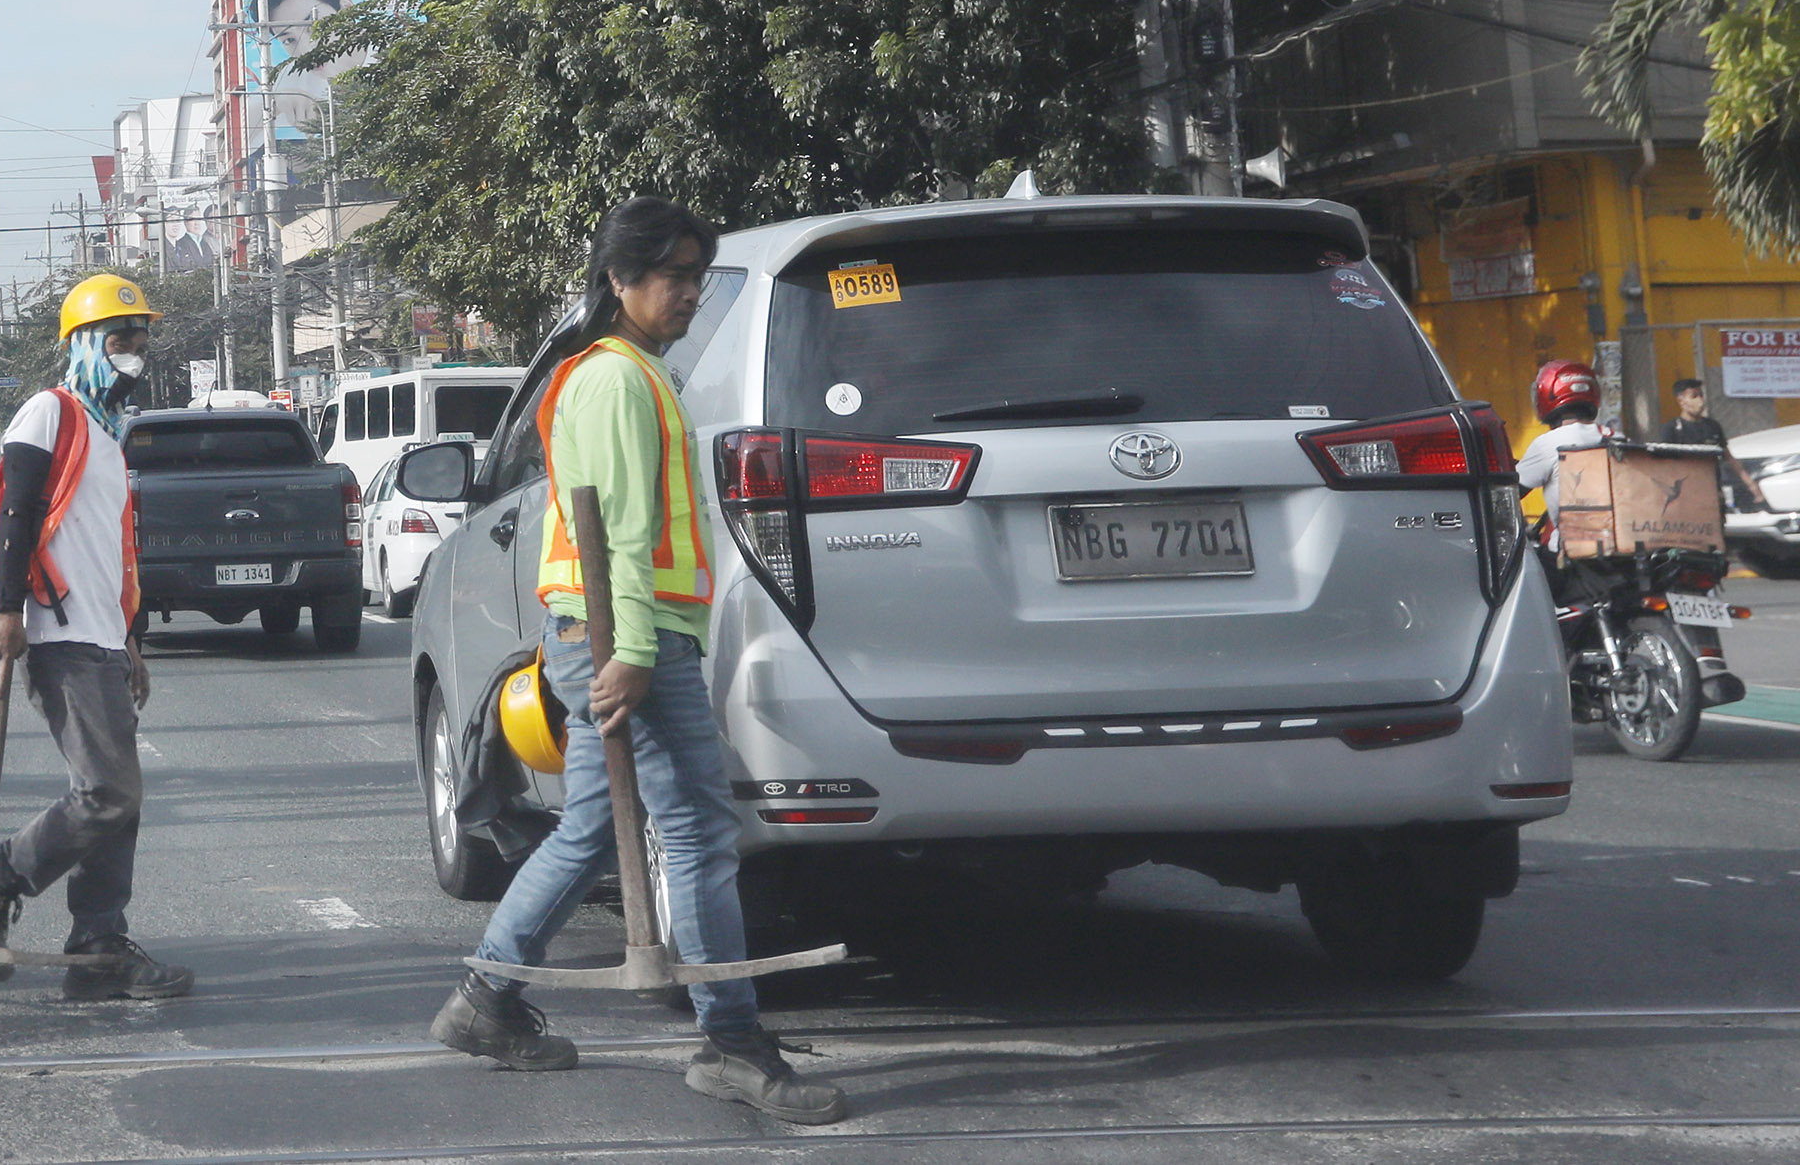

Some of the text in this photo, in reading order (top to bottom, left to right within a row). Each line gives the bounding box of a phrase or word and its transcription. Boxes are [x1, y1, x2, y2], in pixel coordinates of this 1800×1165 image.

[835, 279, 843, 290] A
[844, 272, 894, 297] 0589
[837, 291, 843, 302] 9
[1727, 332, 1777, 346] FOR
[1632, 520, 1714, 535] LALAMOVE
[826, 531, 922, 552] INNOVA
[1061, 519, 1243, 561] NBG 7701
[217, 567, 271, 581] NBT 1341
[815, 783, 851, 793] TRD
